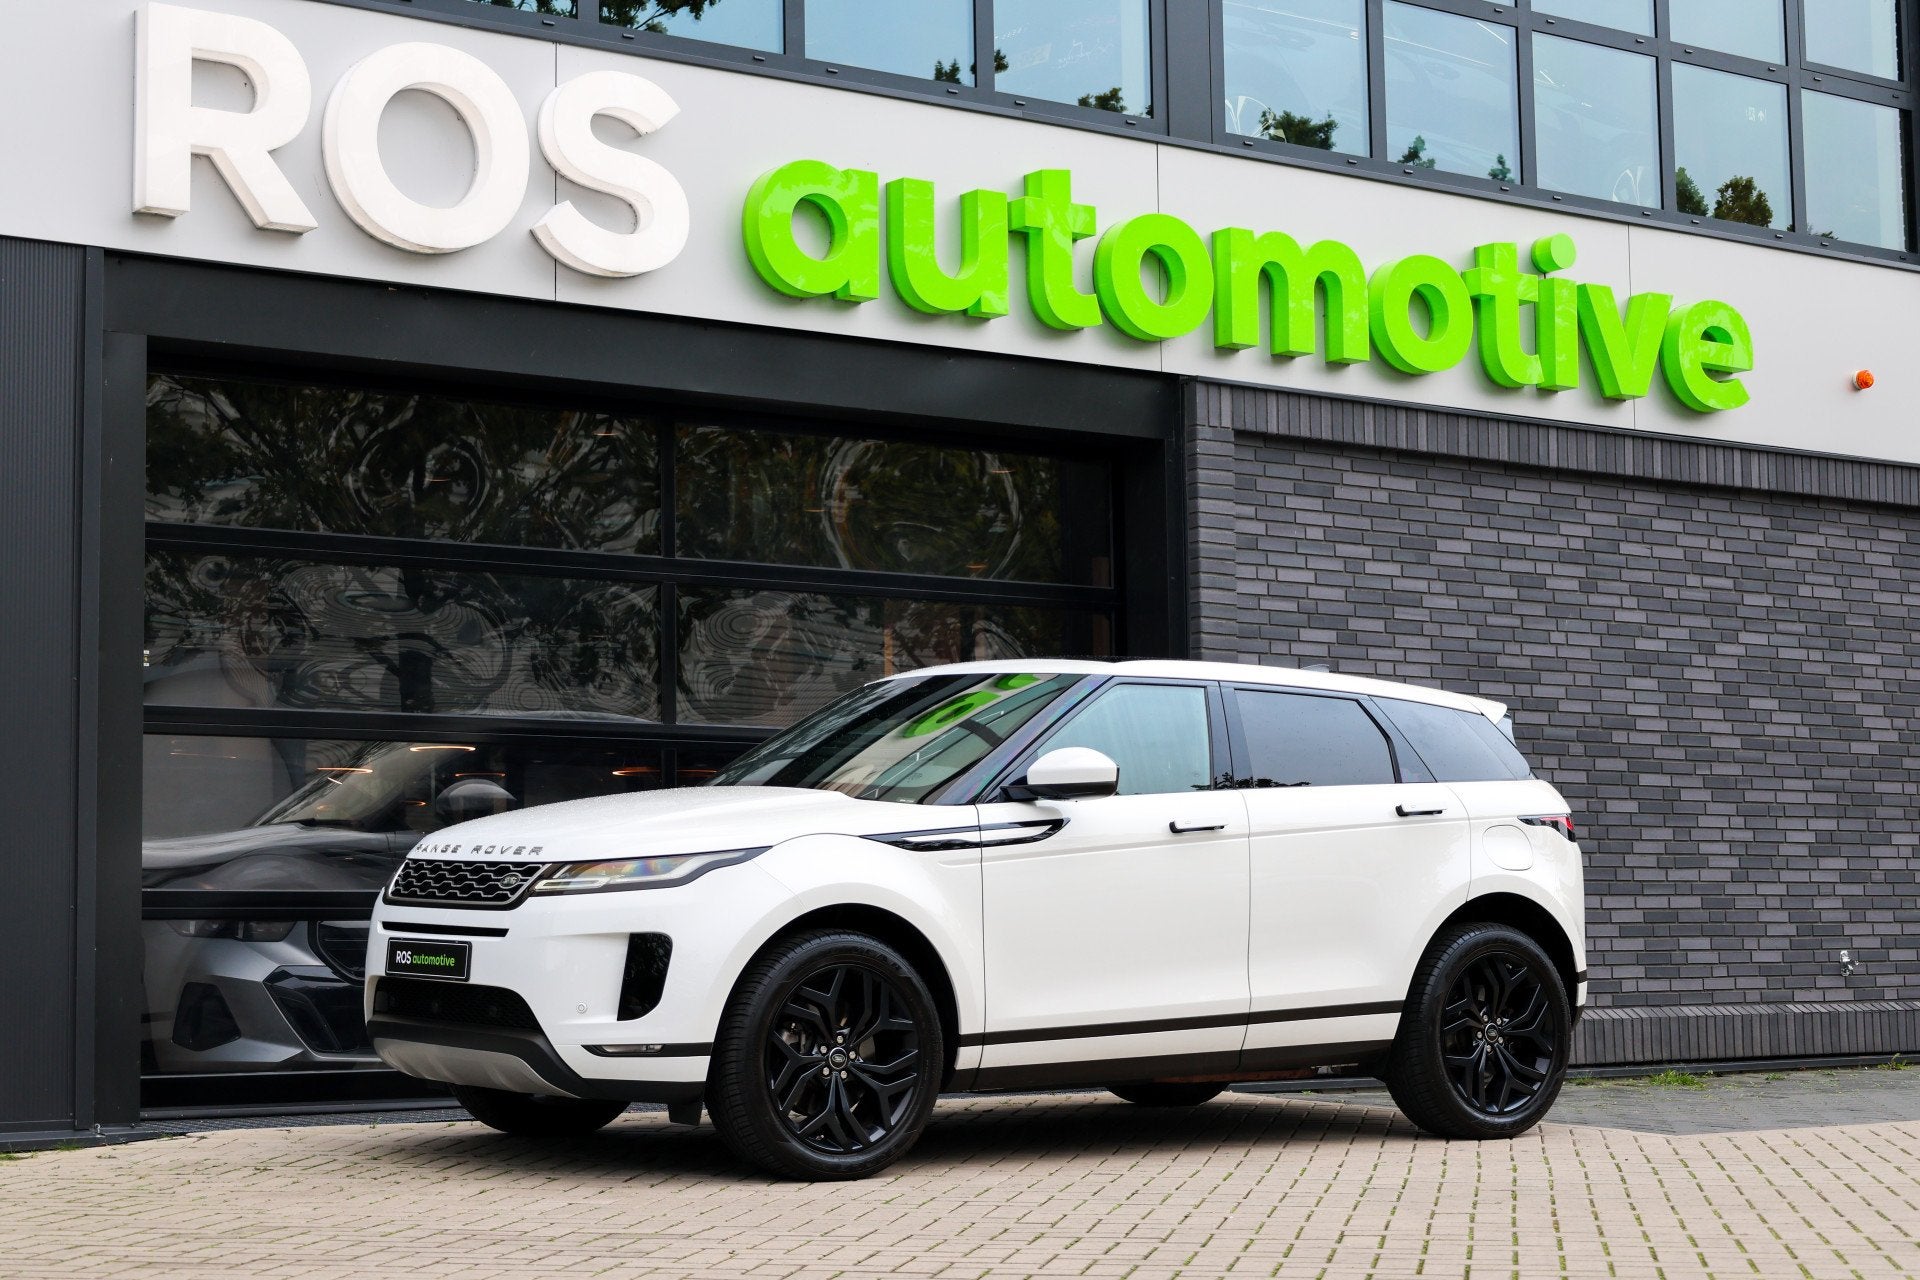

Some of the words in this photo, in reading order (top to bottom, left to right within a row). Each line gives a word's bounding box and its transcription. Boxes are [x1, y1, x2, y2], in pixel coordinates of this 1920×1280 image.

[132, 1, 690, 279] ROS
[742, 159, 1754, 413] automotive
[471, 844, 544, 856] ROVER
[395, 950, 412, 965] ROS
[412, 953, 455, 967] automotive
